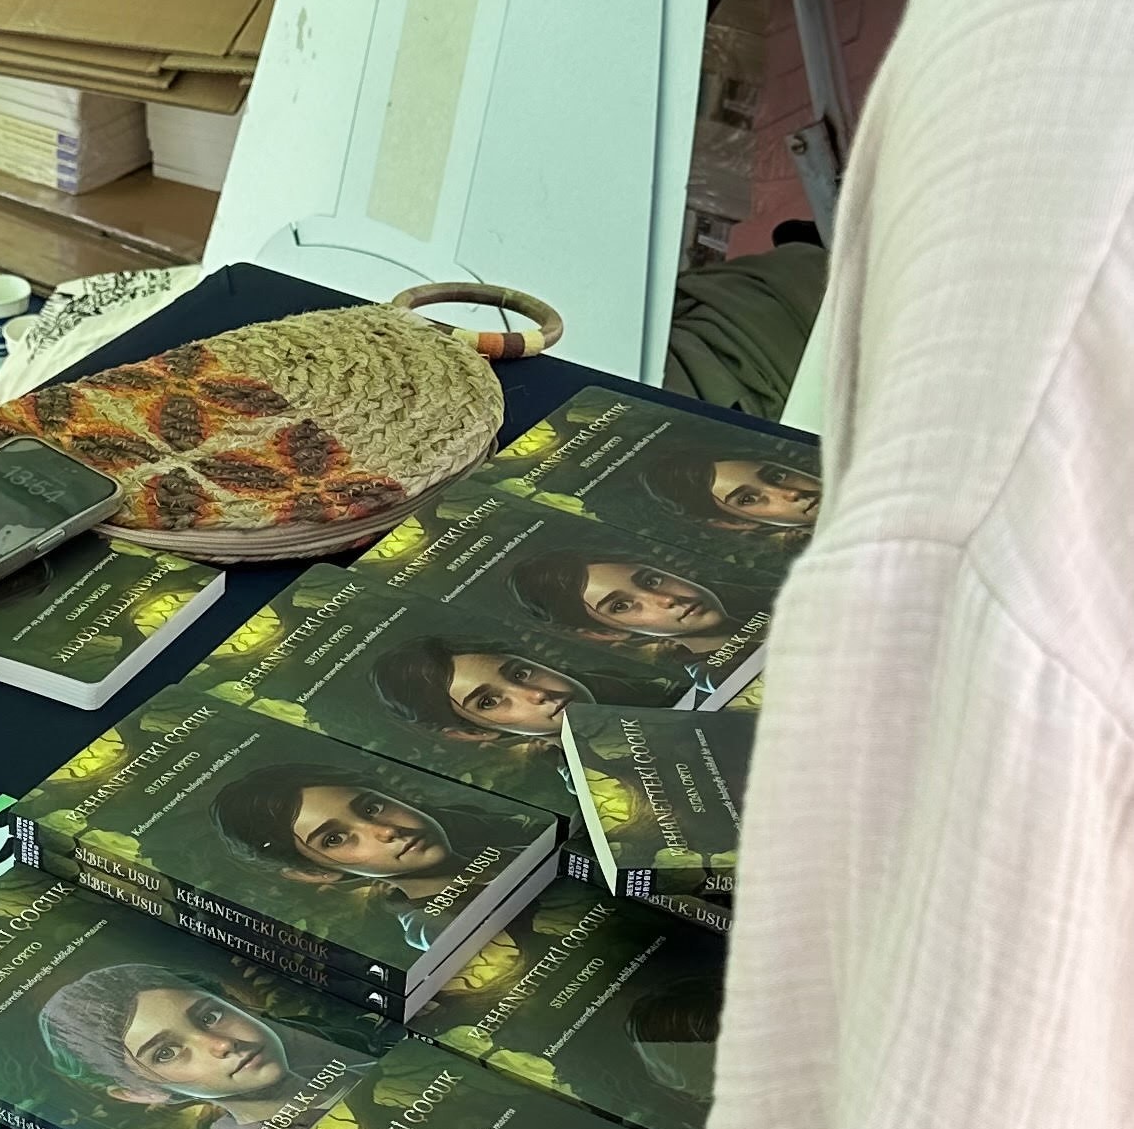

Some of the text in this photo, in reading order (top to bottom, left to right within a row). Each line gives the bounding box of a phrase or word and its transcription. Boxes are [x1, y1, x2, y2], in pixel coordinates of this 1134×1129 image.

[387, 527, 463, 587] EHANETTEKİ
[234, 582, 366, 691] KEHANETTEKİ ÇOCUK
[740, 611, 772, 633] USLU
[66, 706, 218, 821] KEHANETTEKİ ÇOCUK
[620, 718, 653, 764] ÇOCUK
[9, 882, 76, 931] ÇOCUK
[75, 847, 111, 873] SİBEL
[127, 869, 161, 892] USLU
[176, 887, 276, 937] KEHANETTEKİ
[278, 928, 330, 961] ÇOCUK
[424, 885, 468, 917] SİBEL
[464, 846, 501, 874] USLU
[705, 874, 735, 890] SİB
[11, 941, 42, 966] ORTO
[79, 872, 115, 897] SİBEL
[131, 893, 163, 916] USLU
[178, 912, 276, 963] KEHANETTEKİ
[278, 955, 329, 988] ÇOCUK
[468, 903, 615, 1038] KEHANETTEKİ ÇOCUK
[261, 1058, 347, 1129] İBEL K. USLU
[403, 1069, 464, 1124] ÇOCUK
